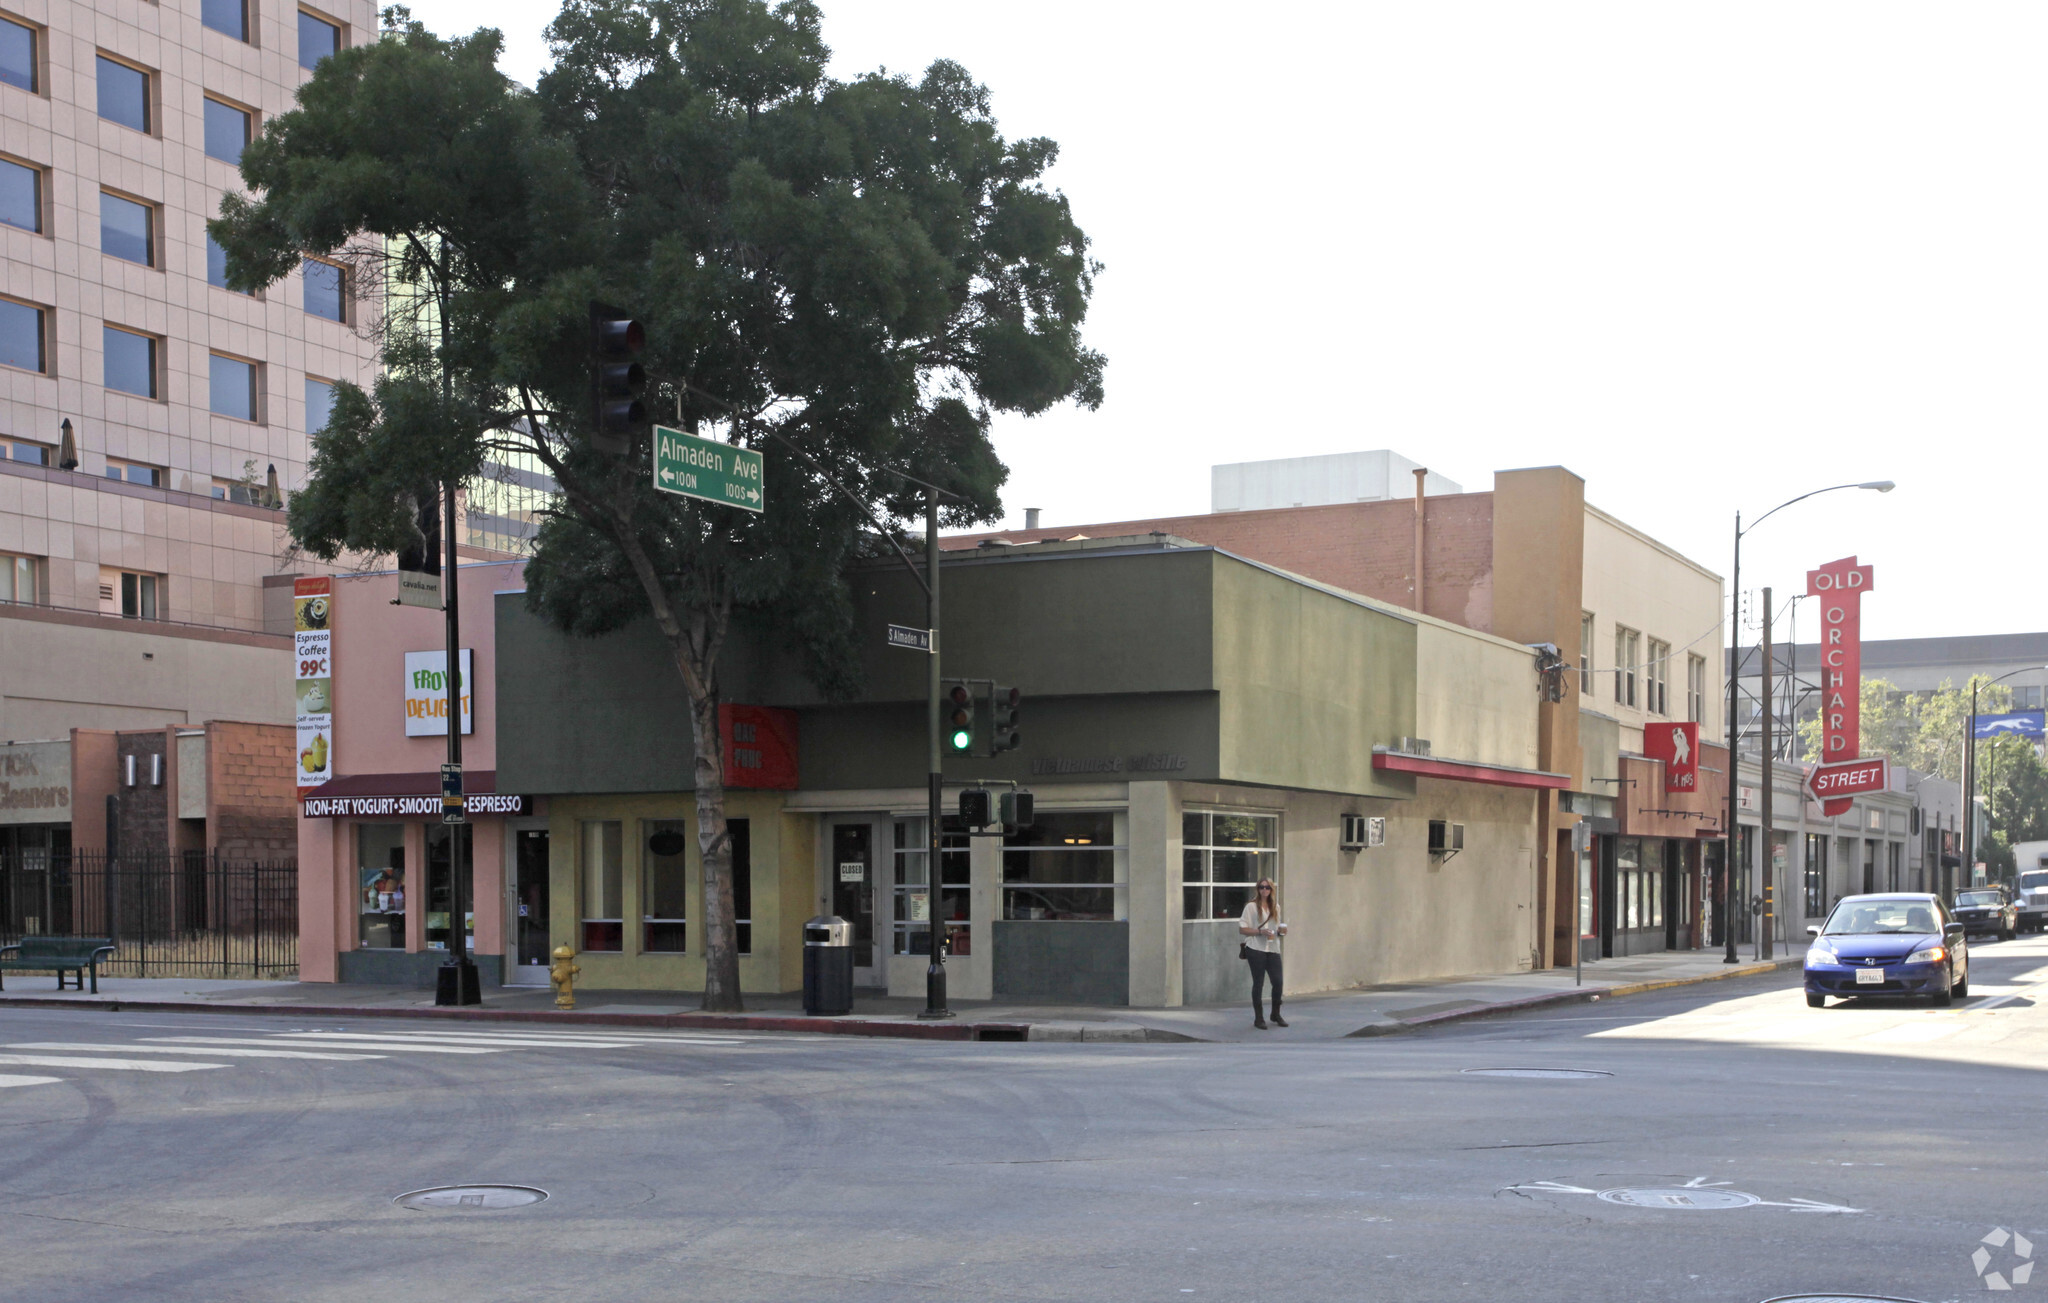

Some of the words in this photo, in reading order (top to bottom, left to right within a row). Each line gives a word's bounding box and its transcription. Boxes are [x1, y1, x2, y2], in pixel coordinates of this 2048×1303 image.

[660, 435, 723, 472] Almaden
[733, 454, 758, 480] Ave
[675, 471, 697, 489] 100N
[725, 482, 746, 500] 100S
[403, 580, 437, 591] cavalia.net
[1815, 571, 1863, 590] OLD
[297, 633, 329, 644] Espresso
[888, 628, 893, 641] S
[893, 629, 918, 646] Almaden
[298, 644, 327, 656] Coffee
[300, 658, 327, 677] 99¢
[413, 669, 463, 691] FROY
[1826, 606, 1846, 752] ORCHARD
[406, 695, 470, 719] DELIGT
[314, 723, 330, 731] Yogurt
[1817, 768, 1880, 789] STREET
[305, 800, 350, 816] NON-FAT
[352, 799, 394, 815] YOGURT
[468, 796, 521, 812] ESPRESSO
[842, 865, 863, 874] CLOSED
